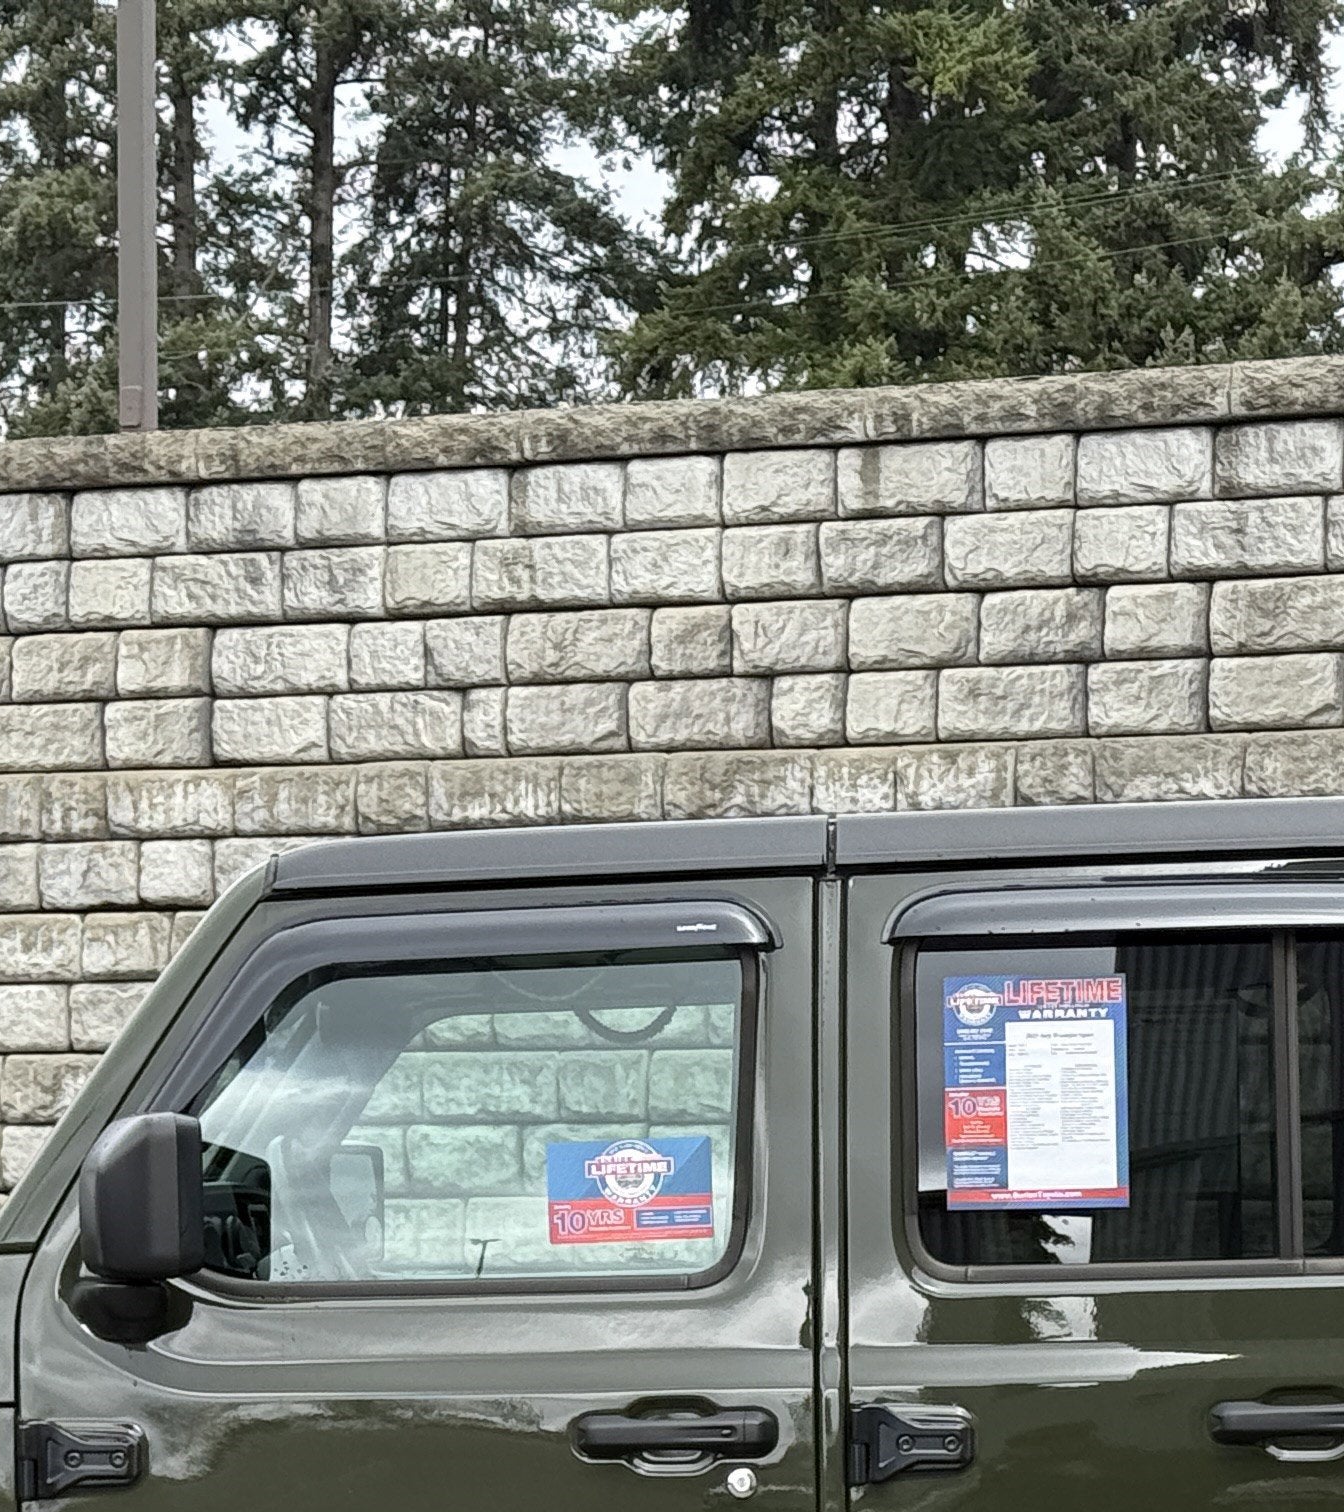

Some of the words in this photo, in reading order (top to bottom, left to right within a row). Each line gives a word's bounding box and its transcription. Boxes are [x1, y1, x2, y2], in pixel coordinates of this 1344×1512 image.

[1004, 977, 1123, 1006] LIFETIME
[1018, 1007, 1109, 1019] WARRANTY
[949, 1098, 977, 1117] 10
[590, 1161, 668, 1175] LIFETIME
[555, 1210, 586, 1235] 10
[587, 1208, 625, 1225] YRS
